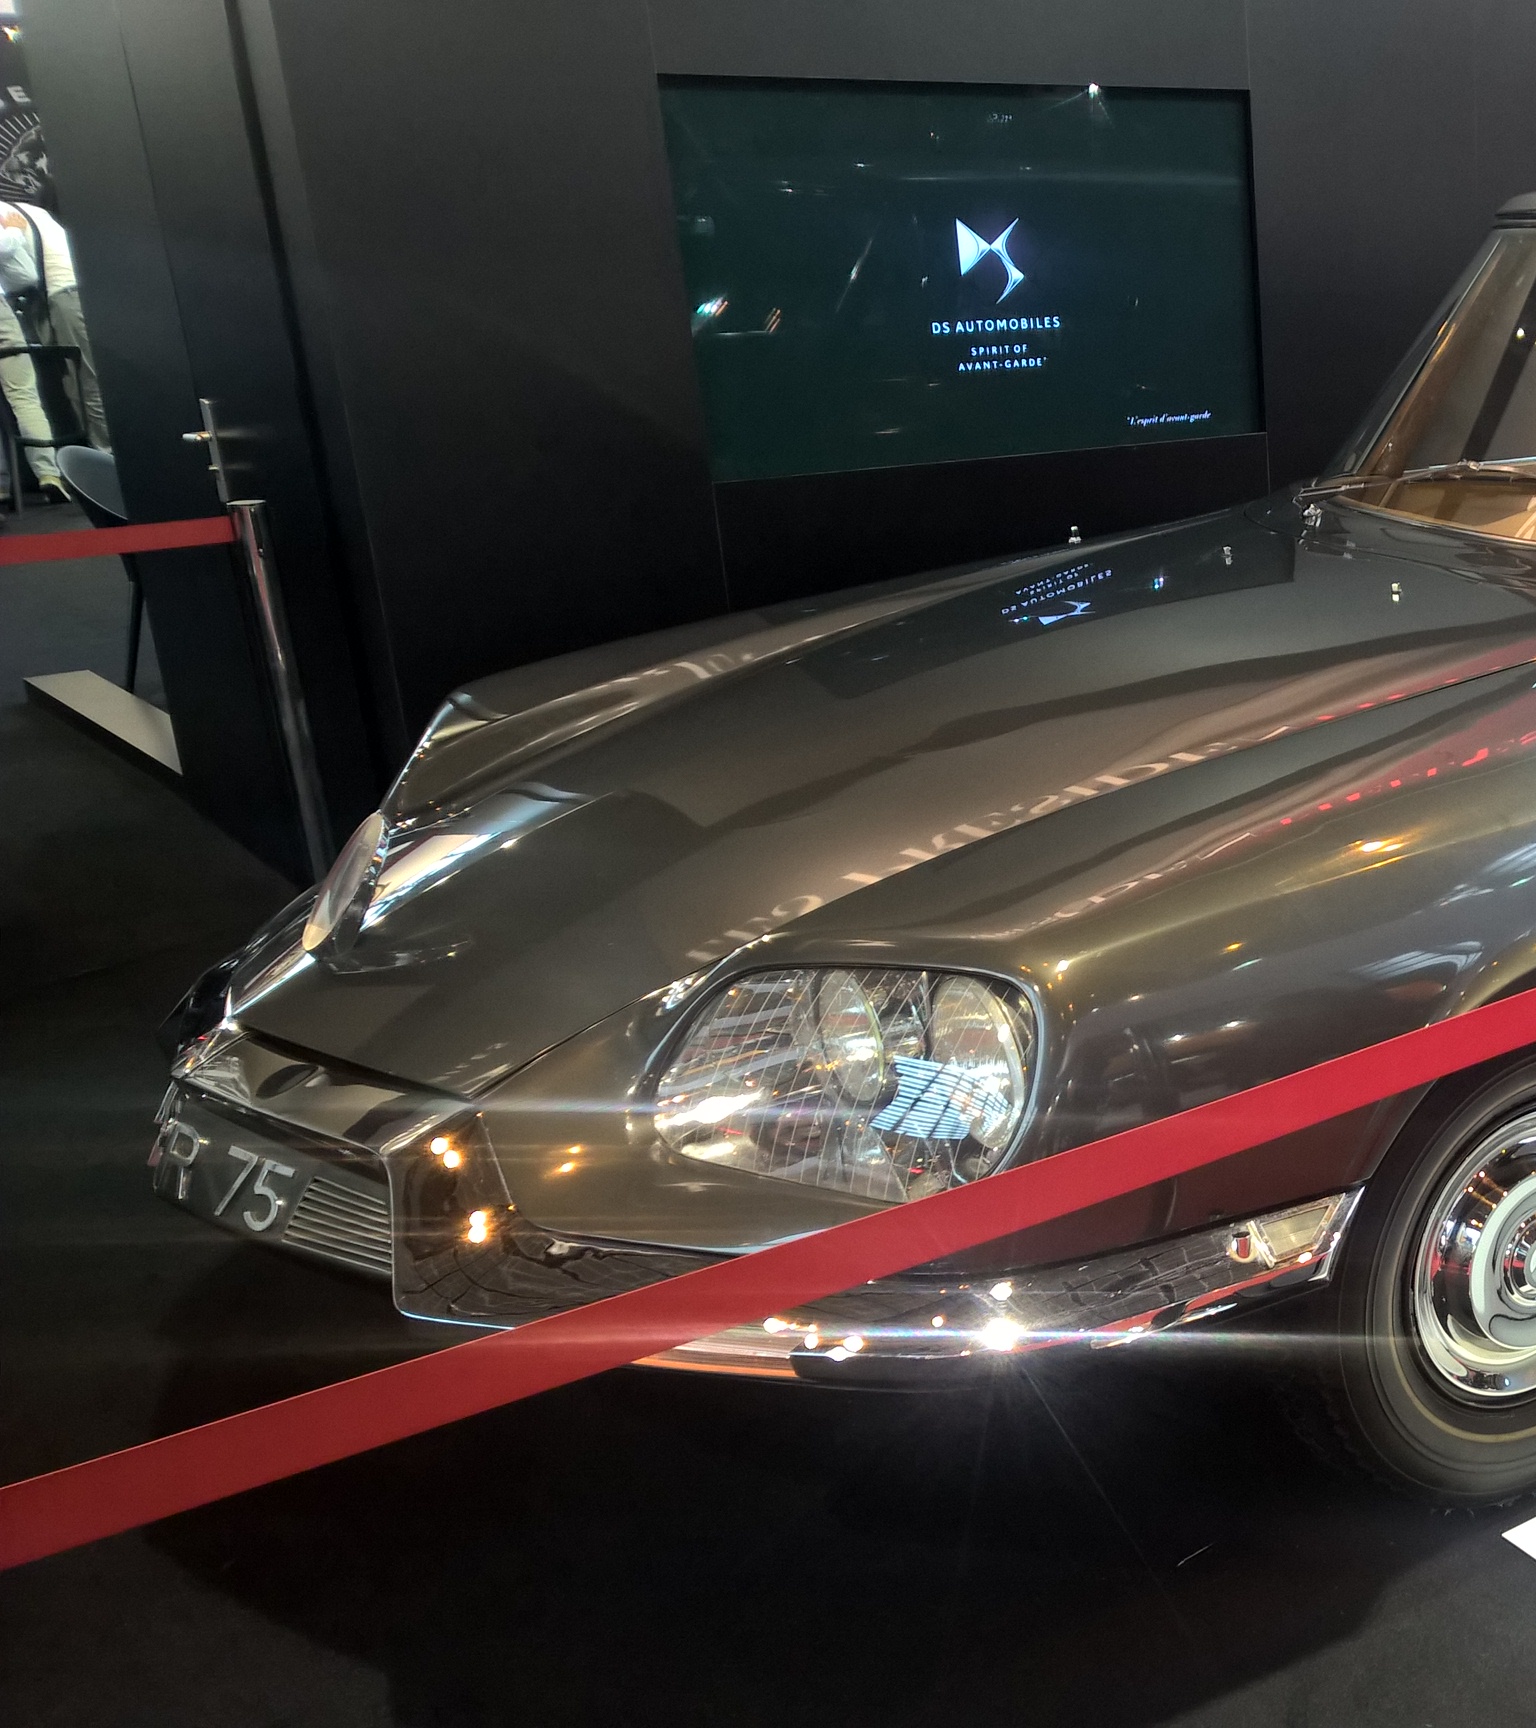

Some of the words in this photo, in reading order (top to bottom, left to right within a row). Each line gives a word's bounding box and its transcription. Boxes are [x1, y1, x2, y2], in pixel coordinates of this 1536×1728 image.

[931, 321, 951, 335] DS
[955, 315, 1061, 334] AUTOMOBILES
[970, 344, 1010, 357] SPIRIT
[1013, 343, 1028, 355] OF
[213, 1145, 296, 1232] 75
